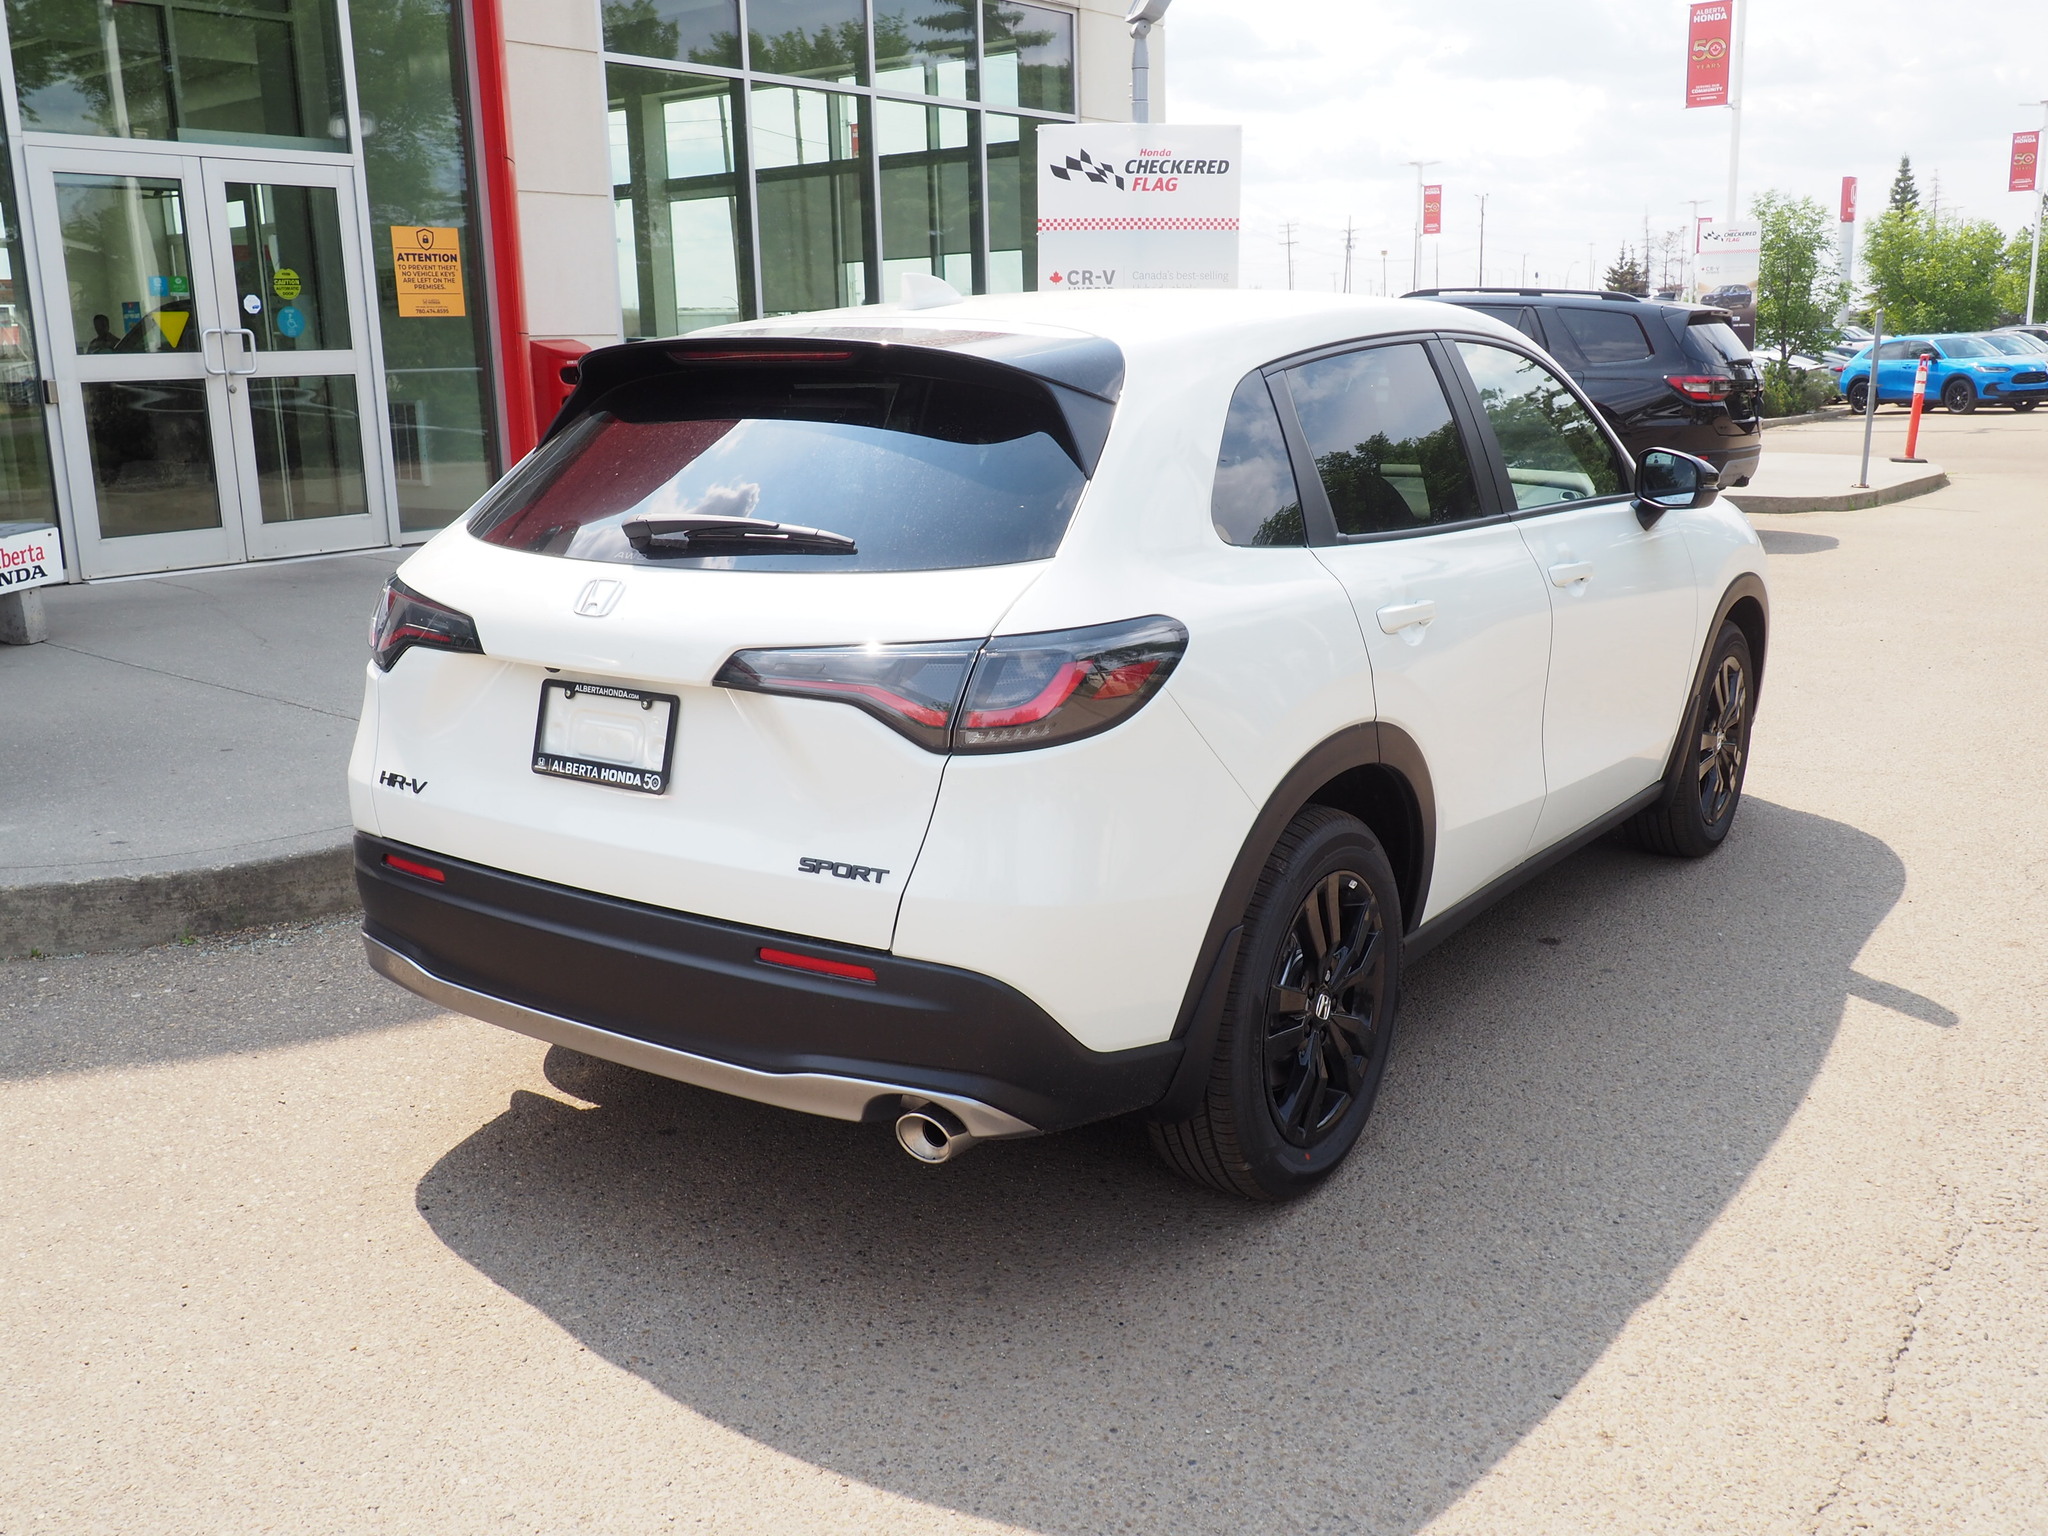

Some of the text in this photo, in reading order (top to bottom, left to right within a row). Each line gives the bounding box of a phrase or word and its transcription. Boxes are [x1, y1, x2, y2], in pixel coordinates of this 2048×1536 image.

[1693, 12, 1728, 23] HONDA
[1696, 7, 1725, 15] ALBERTA
[1692, 37, 1727, 62] 50
[1139, 148, 1172, 157] Honda
[1124, 159, 1230, 175] CHECKERED
[1131, 177, 1179, 192] FLAG
[397, 252, 458, 262] ATTENTION
[1066, 269, 1116, 286] CR-V
[1132, 270, 1229, 284] Canada's best-selling
[0, 544, 45, 569] berta
[379, 770, 428, 794] HR-V
[551, 760, 661, 791] ALBERTA HONDA 50
[798, 856, 890, 884] SPORT
